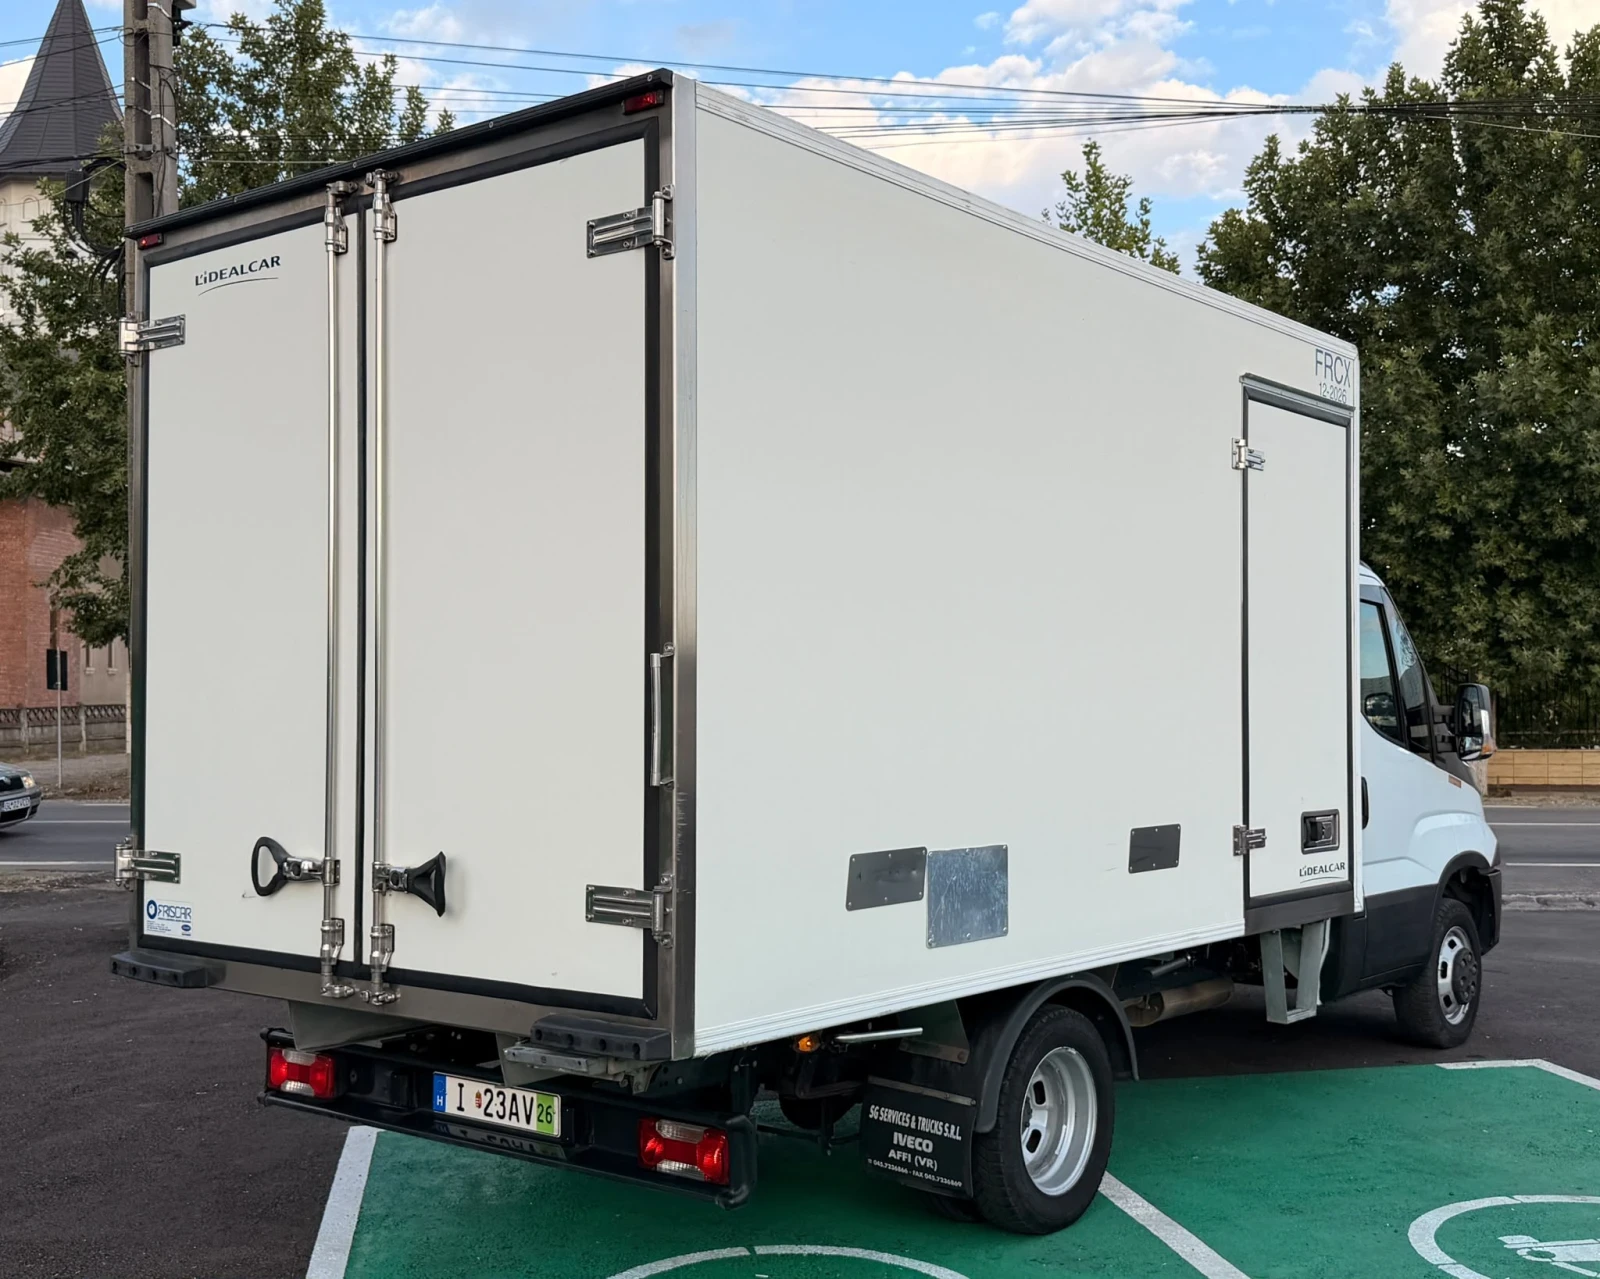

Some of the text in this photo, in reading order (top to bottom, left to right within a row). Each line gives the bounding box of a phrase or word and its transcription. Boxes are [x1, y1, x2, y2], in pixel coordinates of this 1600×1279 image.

[1315, 348, 1351, 388] FRCX
[1319, 382, 1347, 404] 12-2026
[436, 1095, 444, 1107] H
[483, 1088, 534, 1125] 23AV
[537, 1103, 553, 1124] 26
[868, 1104, 880, 1120] SG
[879, 1106, 911, 1128] SERVICES
[910, 1115, 917, 1130] &
[917, 1116, 943, 1136] TRUCKS
[893, 1131, 934, 1153] IVECO
[888, 1149, 938, 1172] AFFI (VR)
[912, 1170, 924, 1179] FAX
